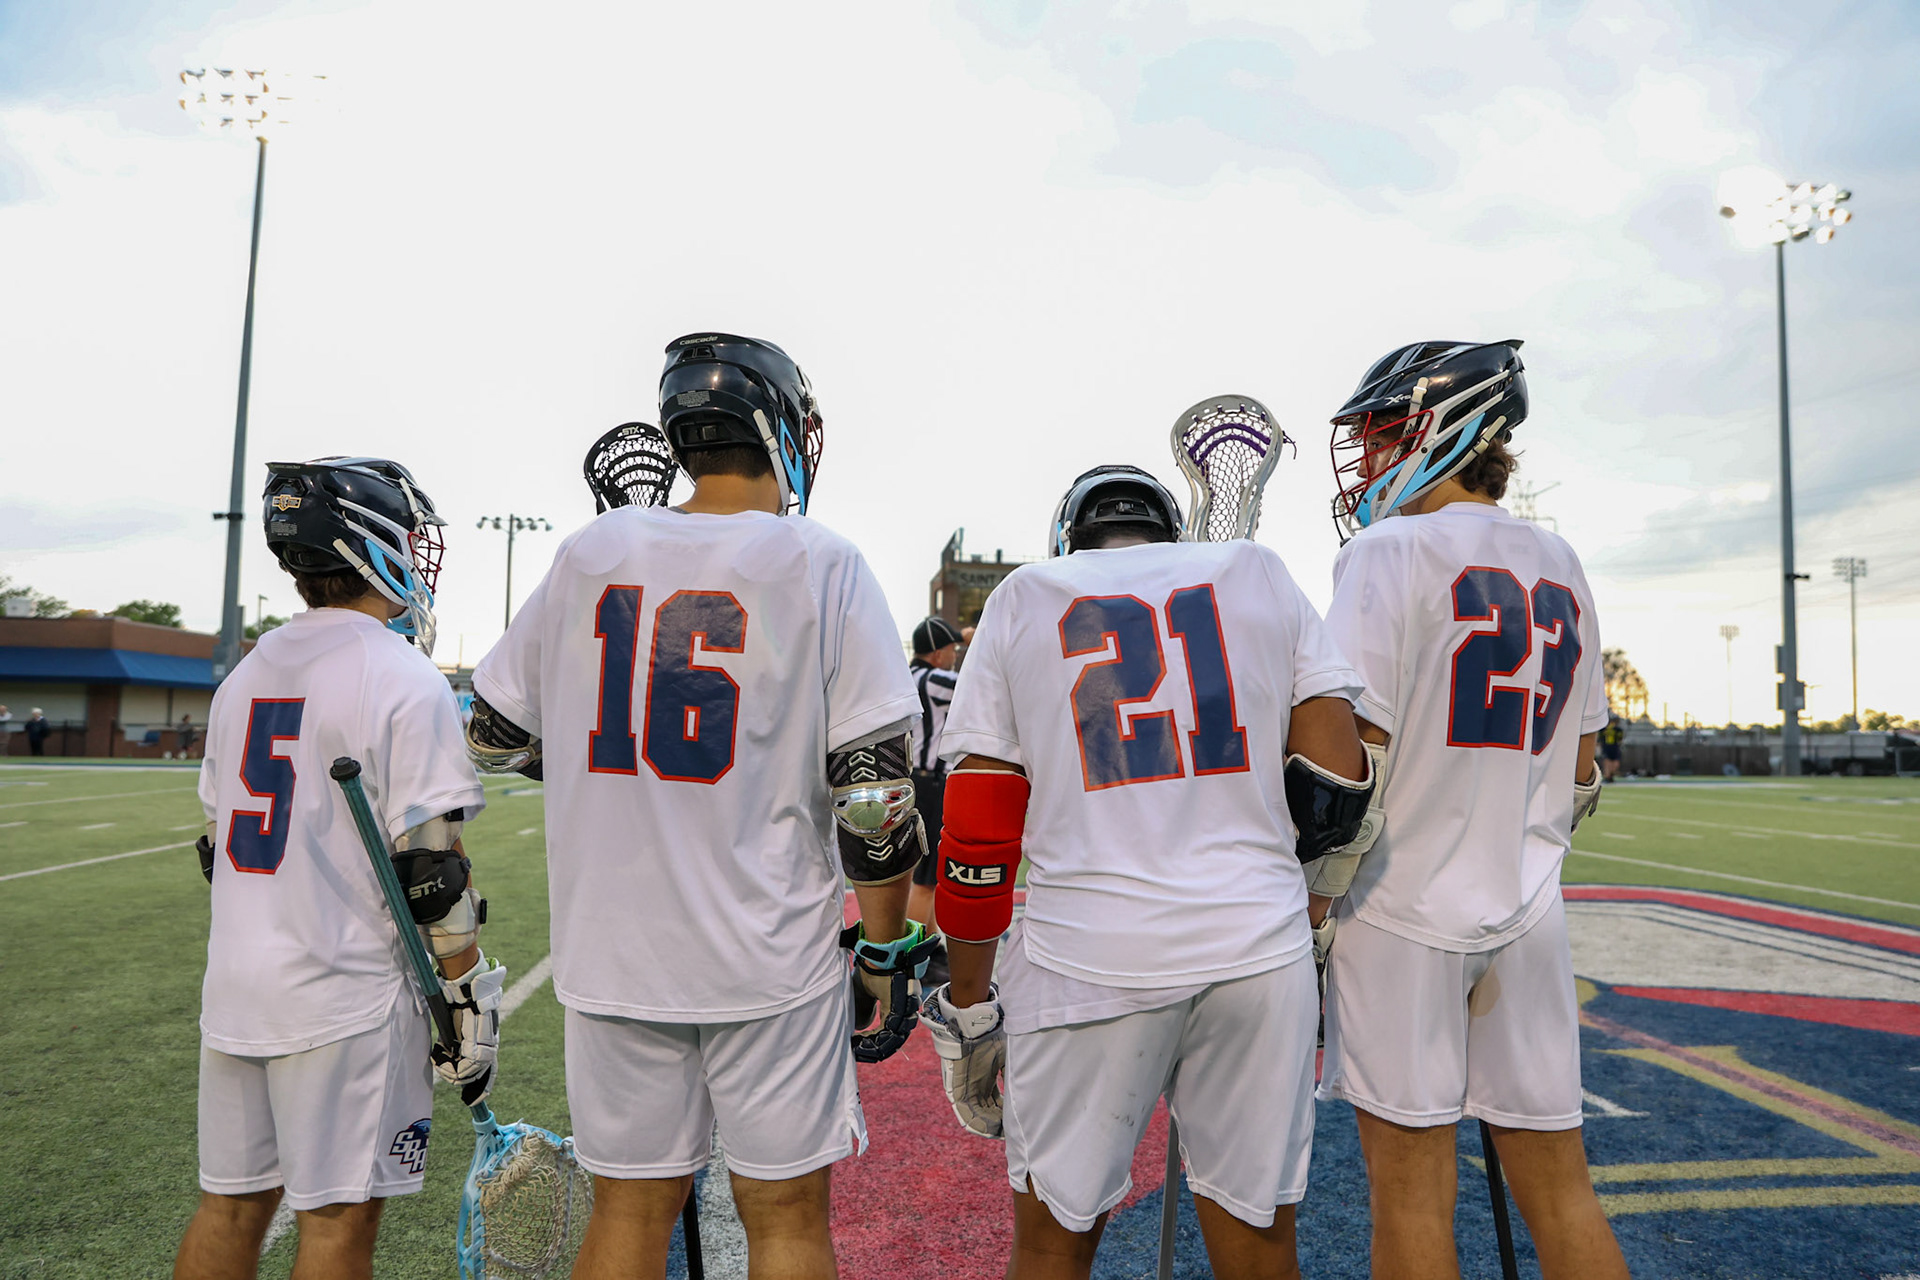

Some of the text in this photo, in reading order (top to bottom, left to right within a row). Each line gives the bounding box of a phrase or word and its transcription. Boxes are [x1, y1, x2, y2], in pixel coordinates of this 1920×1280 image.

[680, 336, 718, 345] cascade
[622, 426, 639, 435] STX
[588, 584, 748, 785] 16
[1058, 583, 1250, 792] 21
[1446, 566, 1582, 756] 23
[226, 697, 306, 875] 5
[409, 876, 446, 899] STX
[948, 861, 1001, 884] STX
